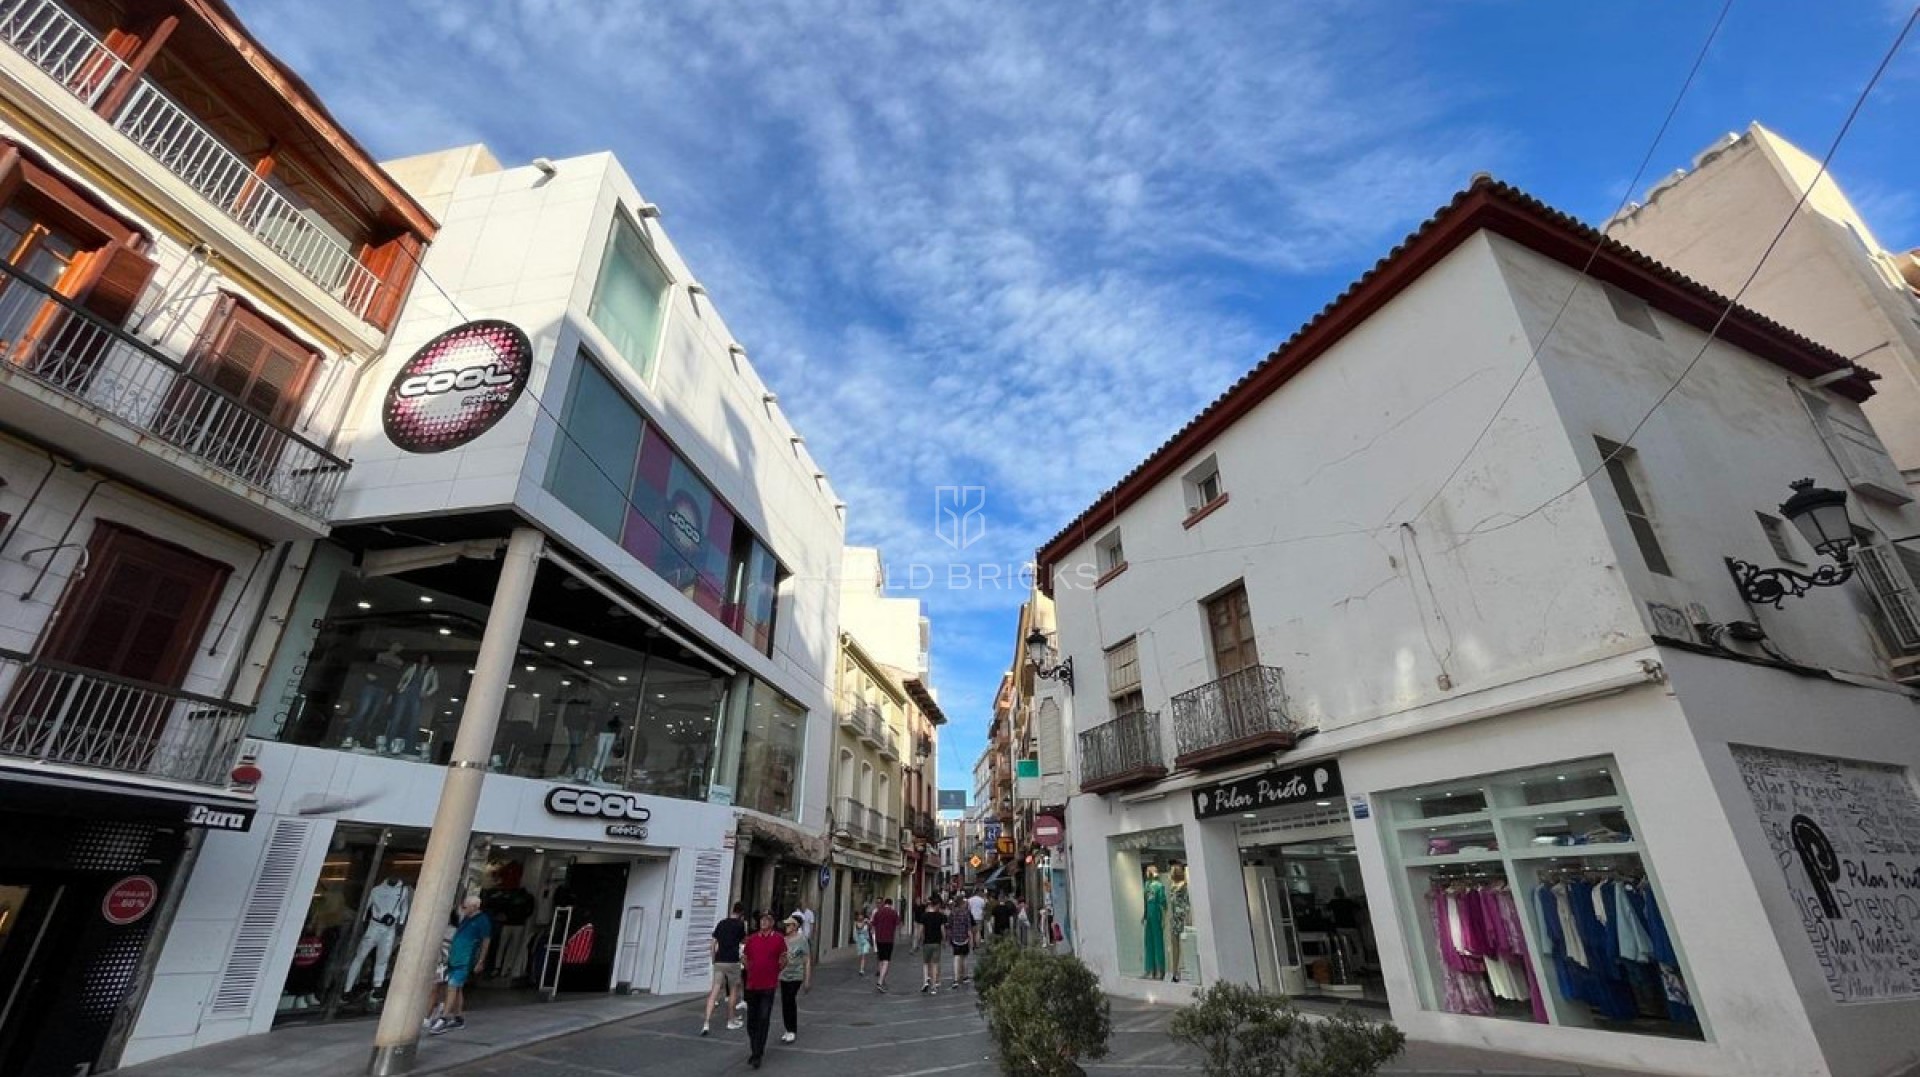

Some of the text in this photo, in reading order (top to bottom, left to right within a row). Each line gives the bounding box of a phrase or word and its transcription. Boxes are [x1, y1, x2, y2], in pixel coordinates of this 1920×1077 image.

[400, 364, 512, 397] COOL
[546, 787, 651, 821] COOL
[1214, 786, 1254, 811] Pilar
[1257, 775, 1307, 804] Prieto
